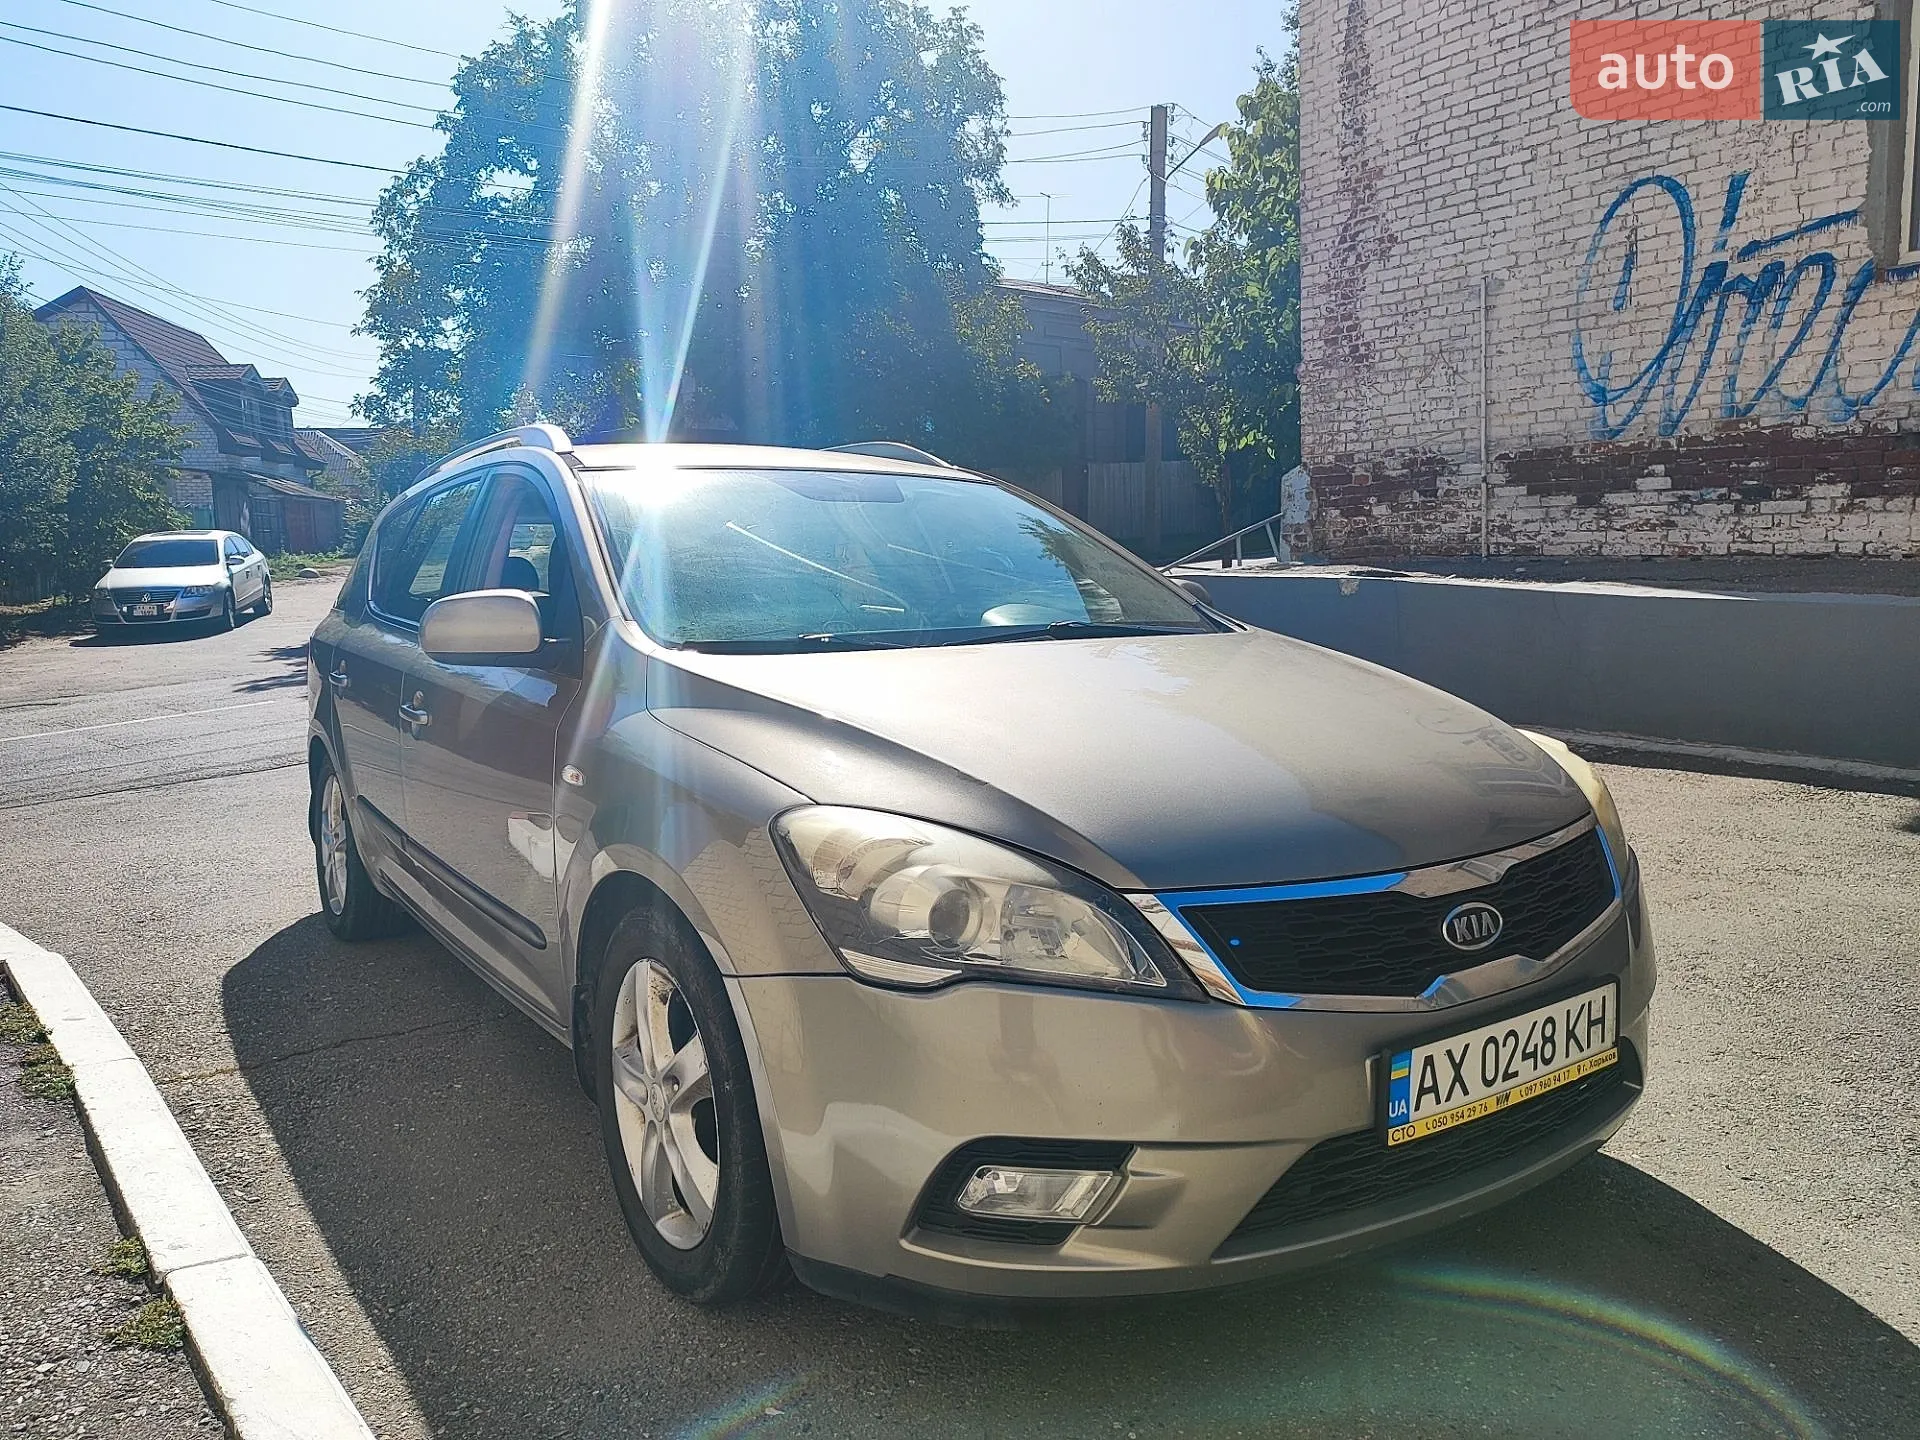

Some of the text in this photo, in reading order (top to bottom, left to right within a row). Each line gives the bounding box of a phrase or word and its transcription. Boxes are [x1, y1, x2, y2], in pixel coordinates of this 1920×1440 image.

[1453, 911, 1496, 942] KIA
[1413, 995, 1606, 1112] AX 0248 KH
[1389, 1099, 1407, 1118] UA
[1432, 1115, 1448, 1129] 050
[1450, 1109, 1465, 1122] 954
[1466, 1106, 1477, 1118] 29
[1479, 1101, 1488, 1114] 76
